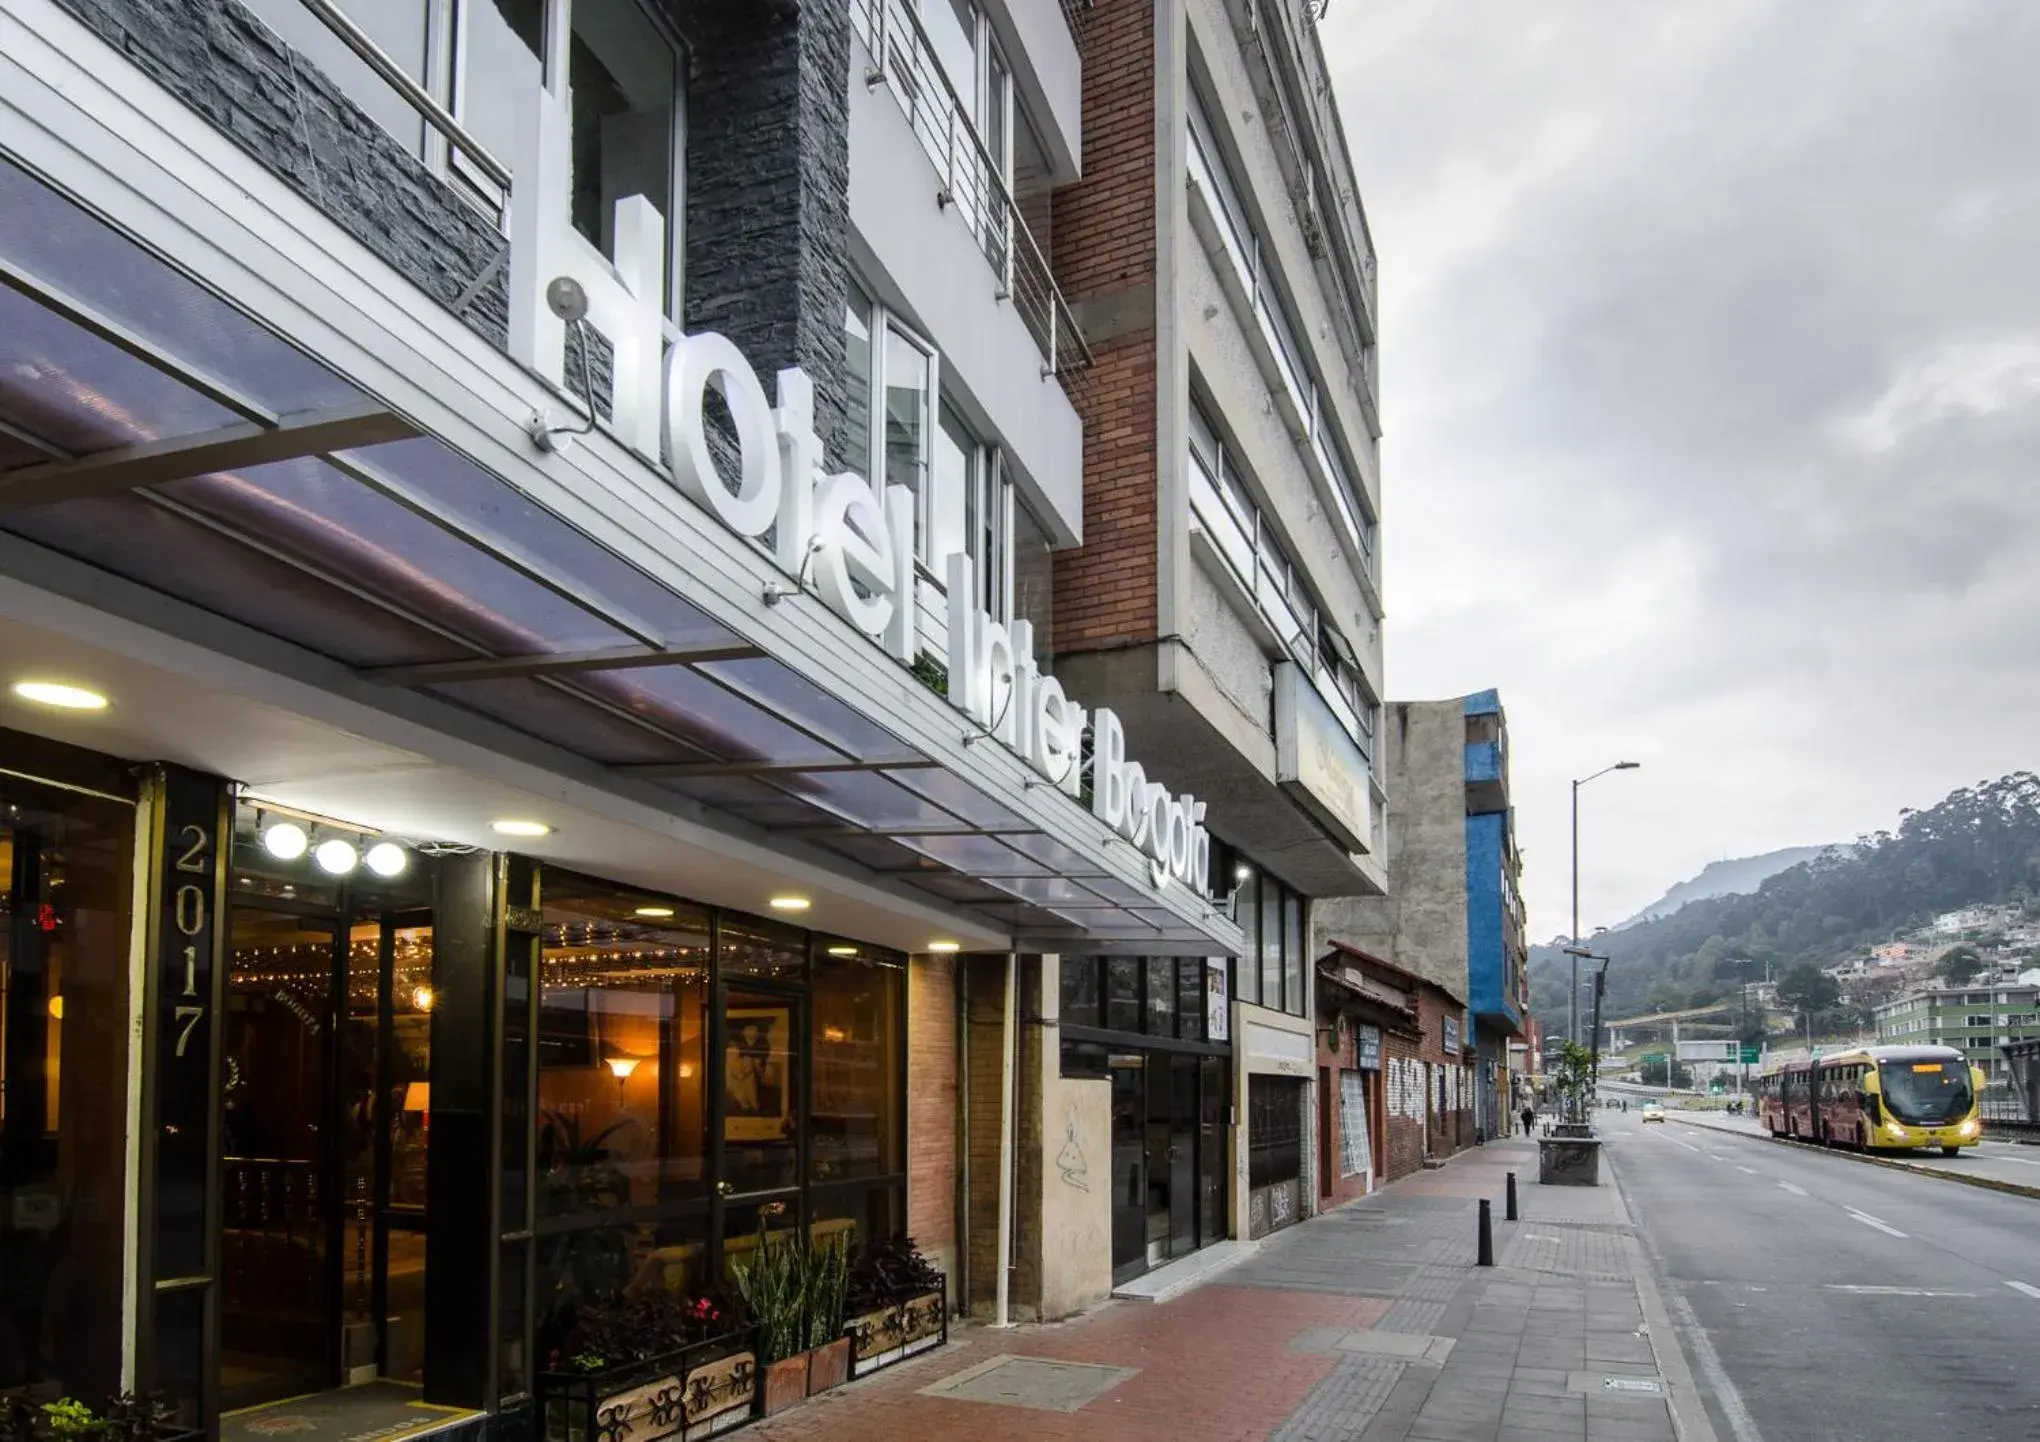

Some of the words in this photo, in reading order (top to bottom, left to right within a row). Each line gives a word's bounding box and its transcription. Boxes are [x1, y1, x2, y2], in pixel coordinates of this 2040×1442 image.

[507, 85, 914, 665] Hotel
[947, 552, 1087, 797] Inter
[1093, 708, 1212, 899] Bogotá
[175, 824, 207, 1057] 2017
